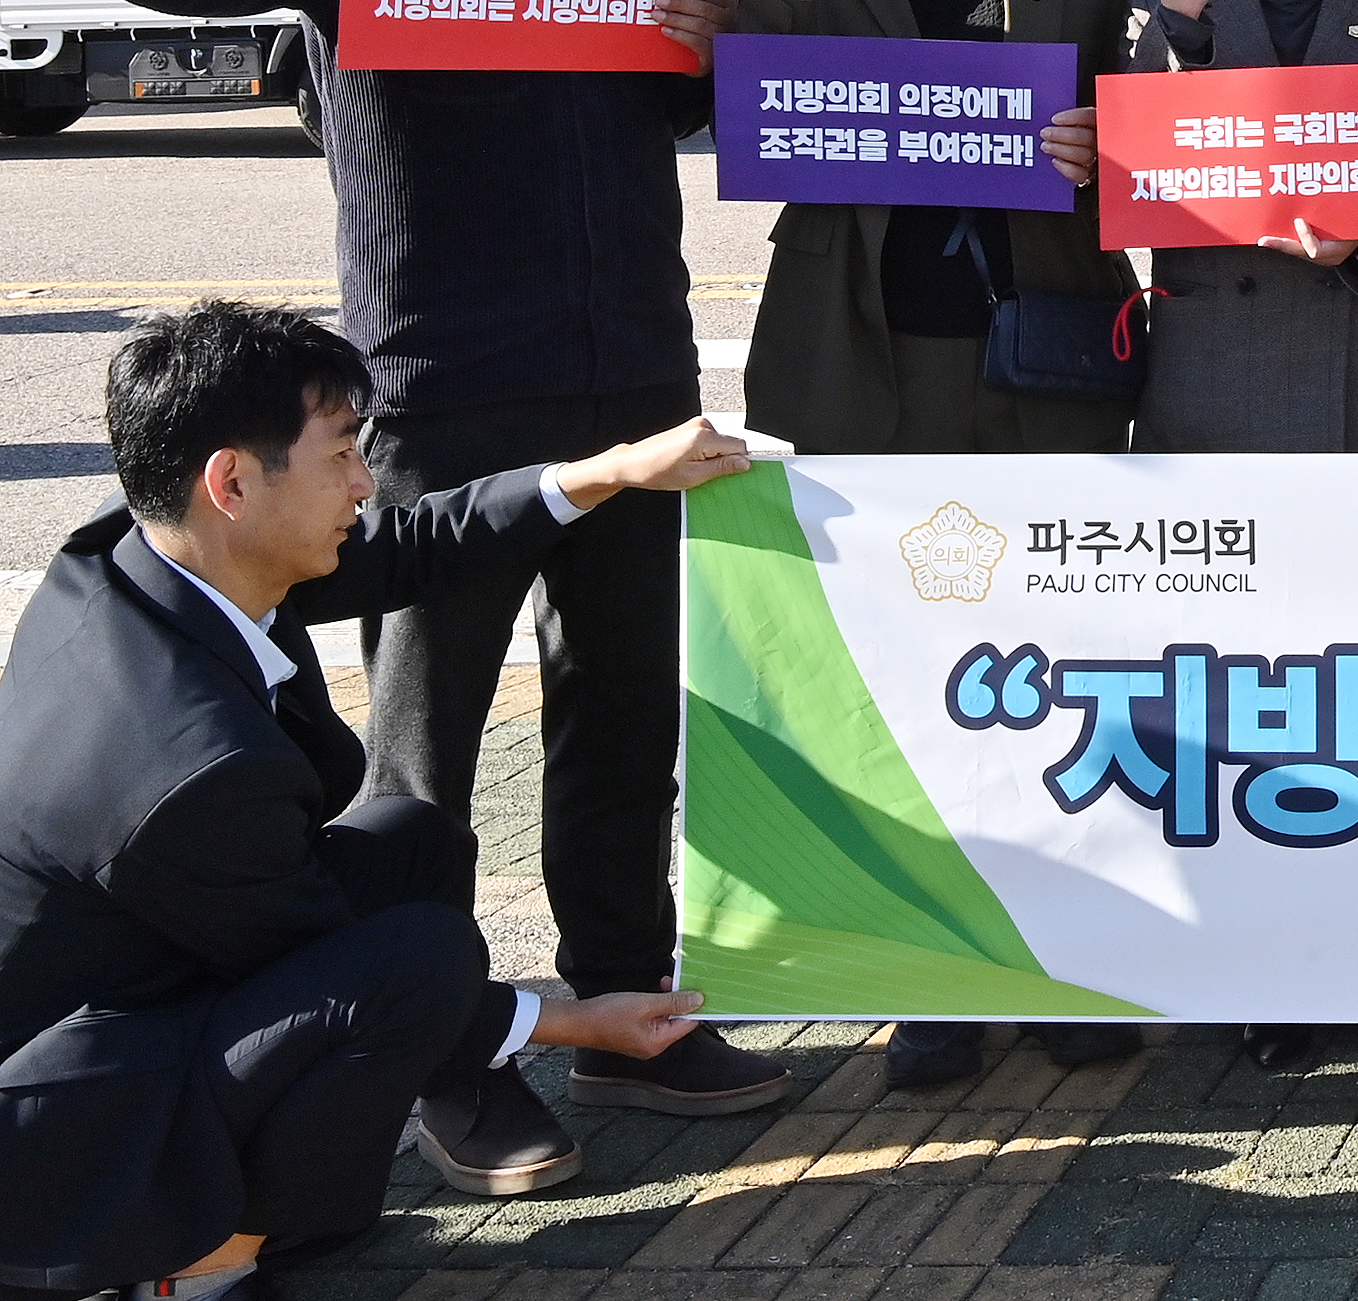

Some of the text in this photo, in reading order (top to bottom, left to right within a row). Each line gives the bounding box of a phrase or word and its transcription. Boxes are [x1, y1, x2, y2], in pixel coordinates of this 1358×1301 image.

[759, 79, 1032, 120] 지방의회 의장에게
[759, 127, 1034, 167] 조직권을 부여하라!
[1173, 115, 1265, 150] 국회는
[1131, 165, 1263, 202] 지방의회는
[932, 545, 971, 567] 의회
[1027, 518, 1257, 566] 파주시의회
[1027, 573, 1257, 593] PAJU CITY COUNCIL
